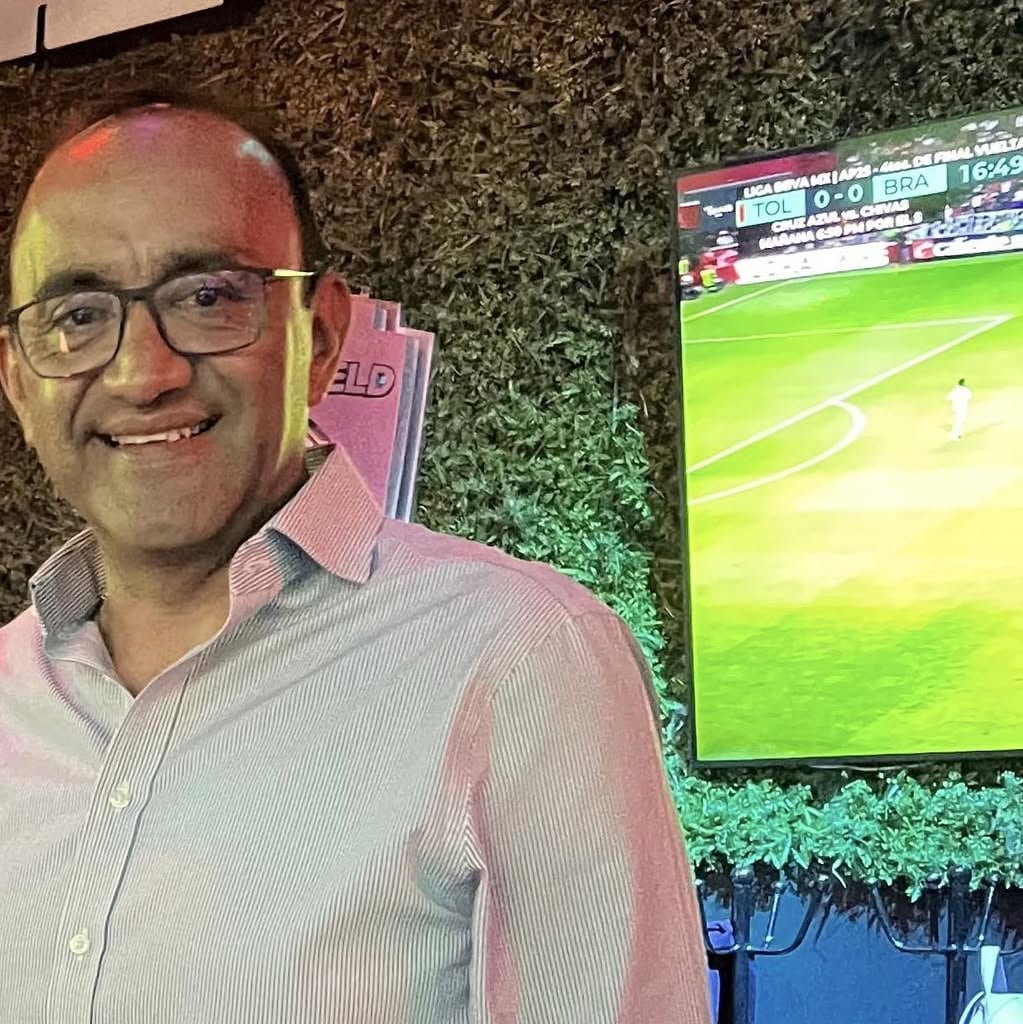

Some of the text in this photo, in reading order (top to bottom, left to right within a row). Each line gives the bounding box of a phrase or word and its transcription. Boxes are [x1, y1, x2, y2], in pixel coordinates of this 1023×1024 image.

[753, 199, 792, 217] TOL
[814, 189, 831, 209] 0
[847, 183, 864, 203] 0
[885, 174, 929, 196] BRA
[959, 154, 1023, 184] 16:49
